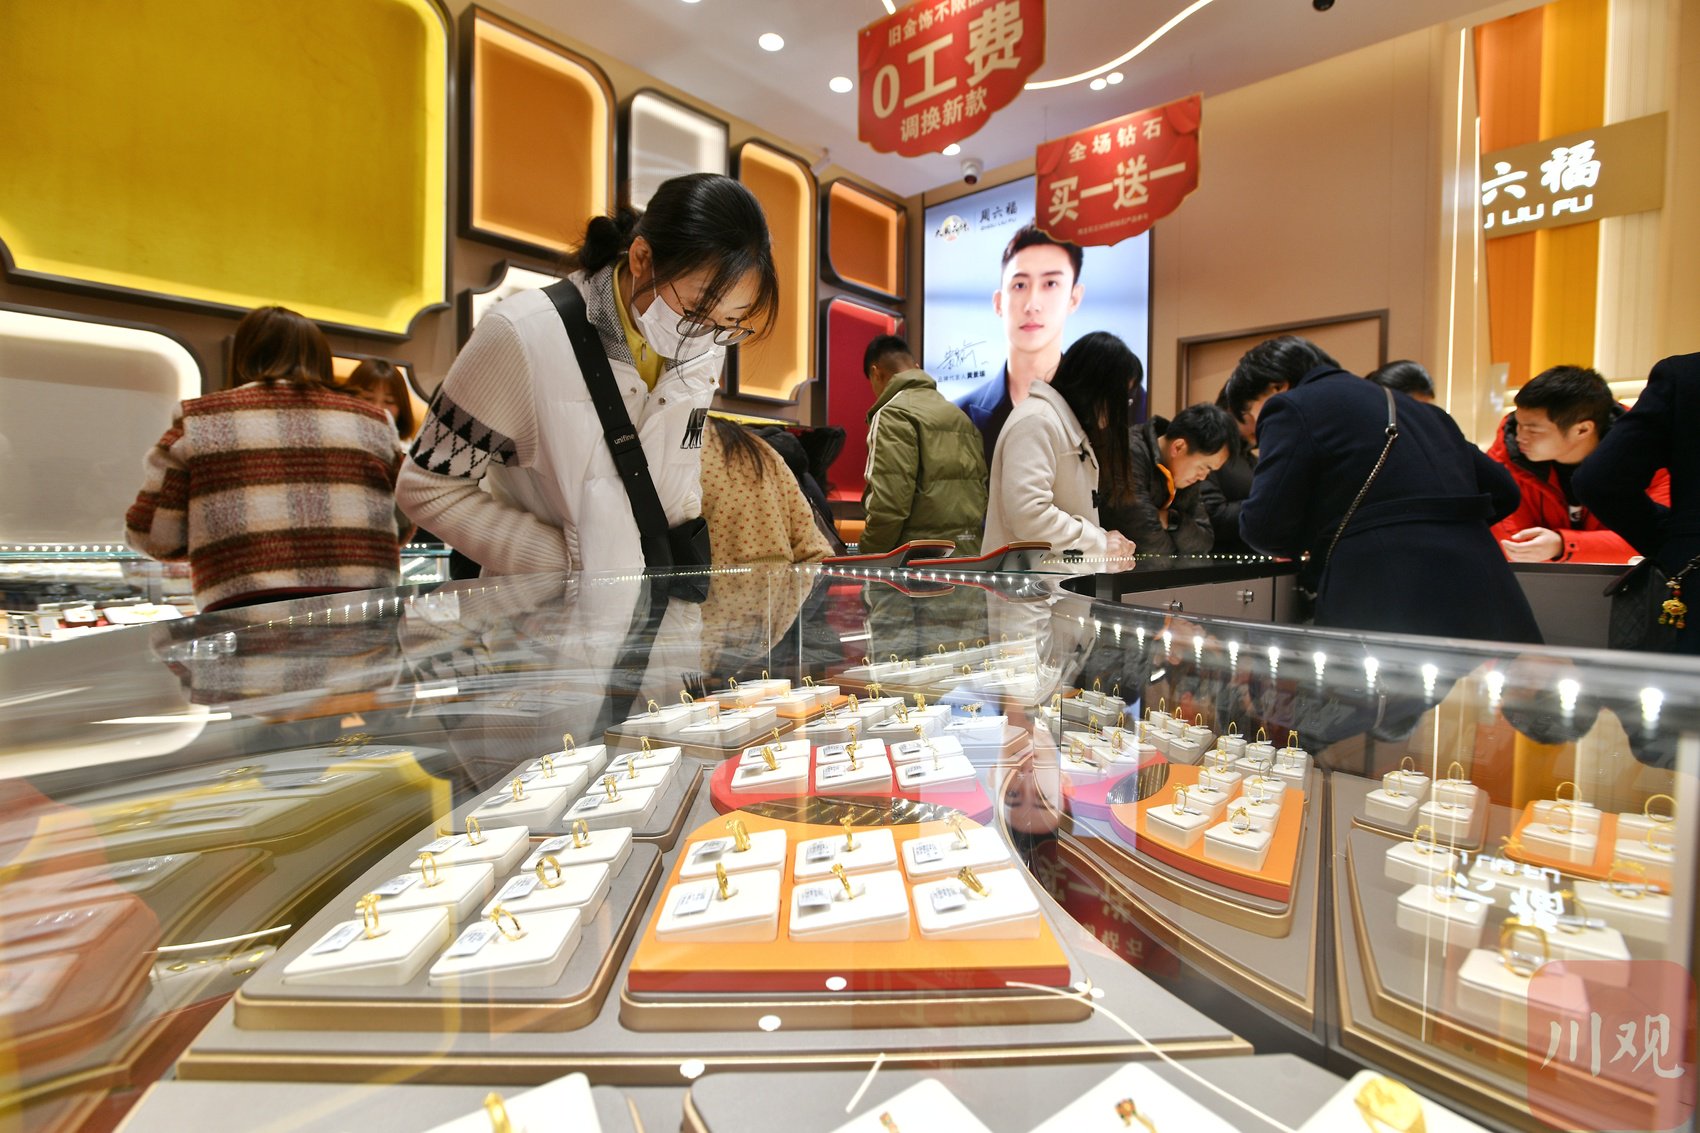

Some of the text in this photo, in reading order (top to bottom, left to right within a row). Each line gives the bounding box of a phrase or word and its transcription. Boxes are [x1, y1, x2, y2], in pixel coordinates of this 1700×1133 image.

[872, 1, 1024, 119] 0工费
[901, 87, 987, 142] 调换新款
[1068, 116, 1163, 164] 全场钻石
[1048, 155, 1186, 226] 买一送一
[1552, 194, 1593, 216] FU
